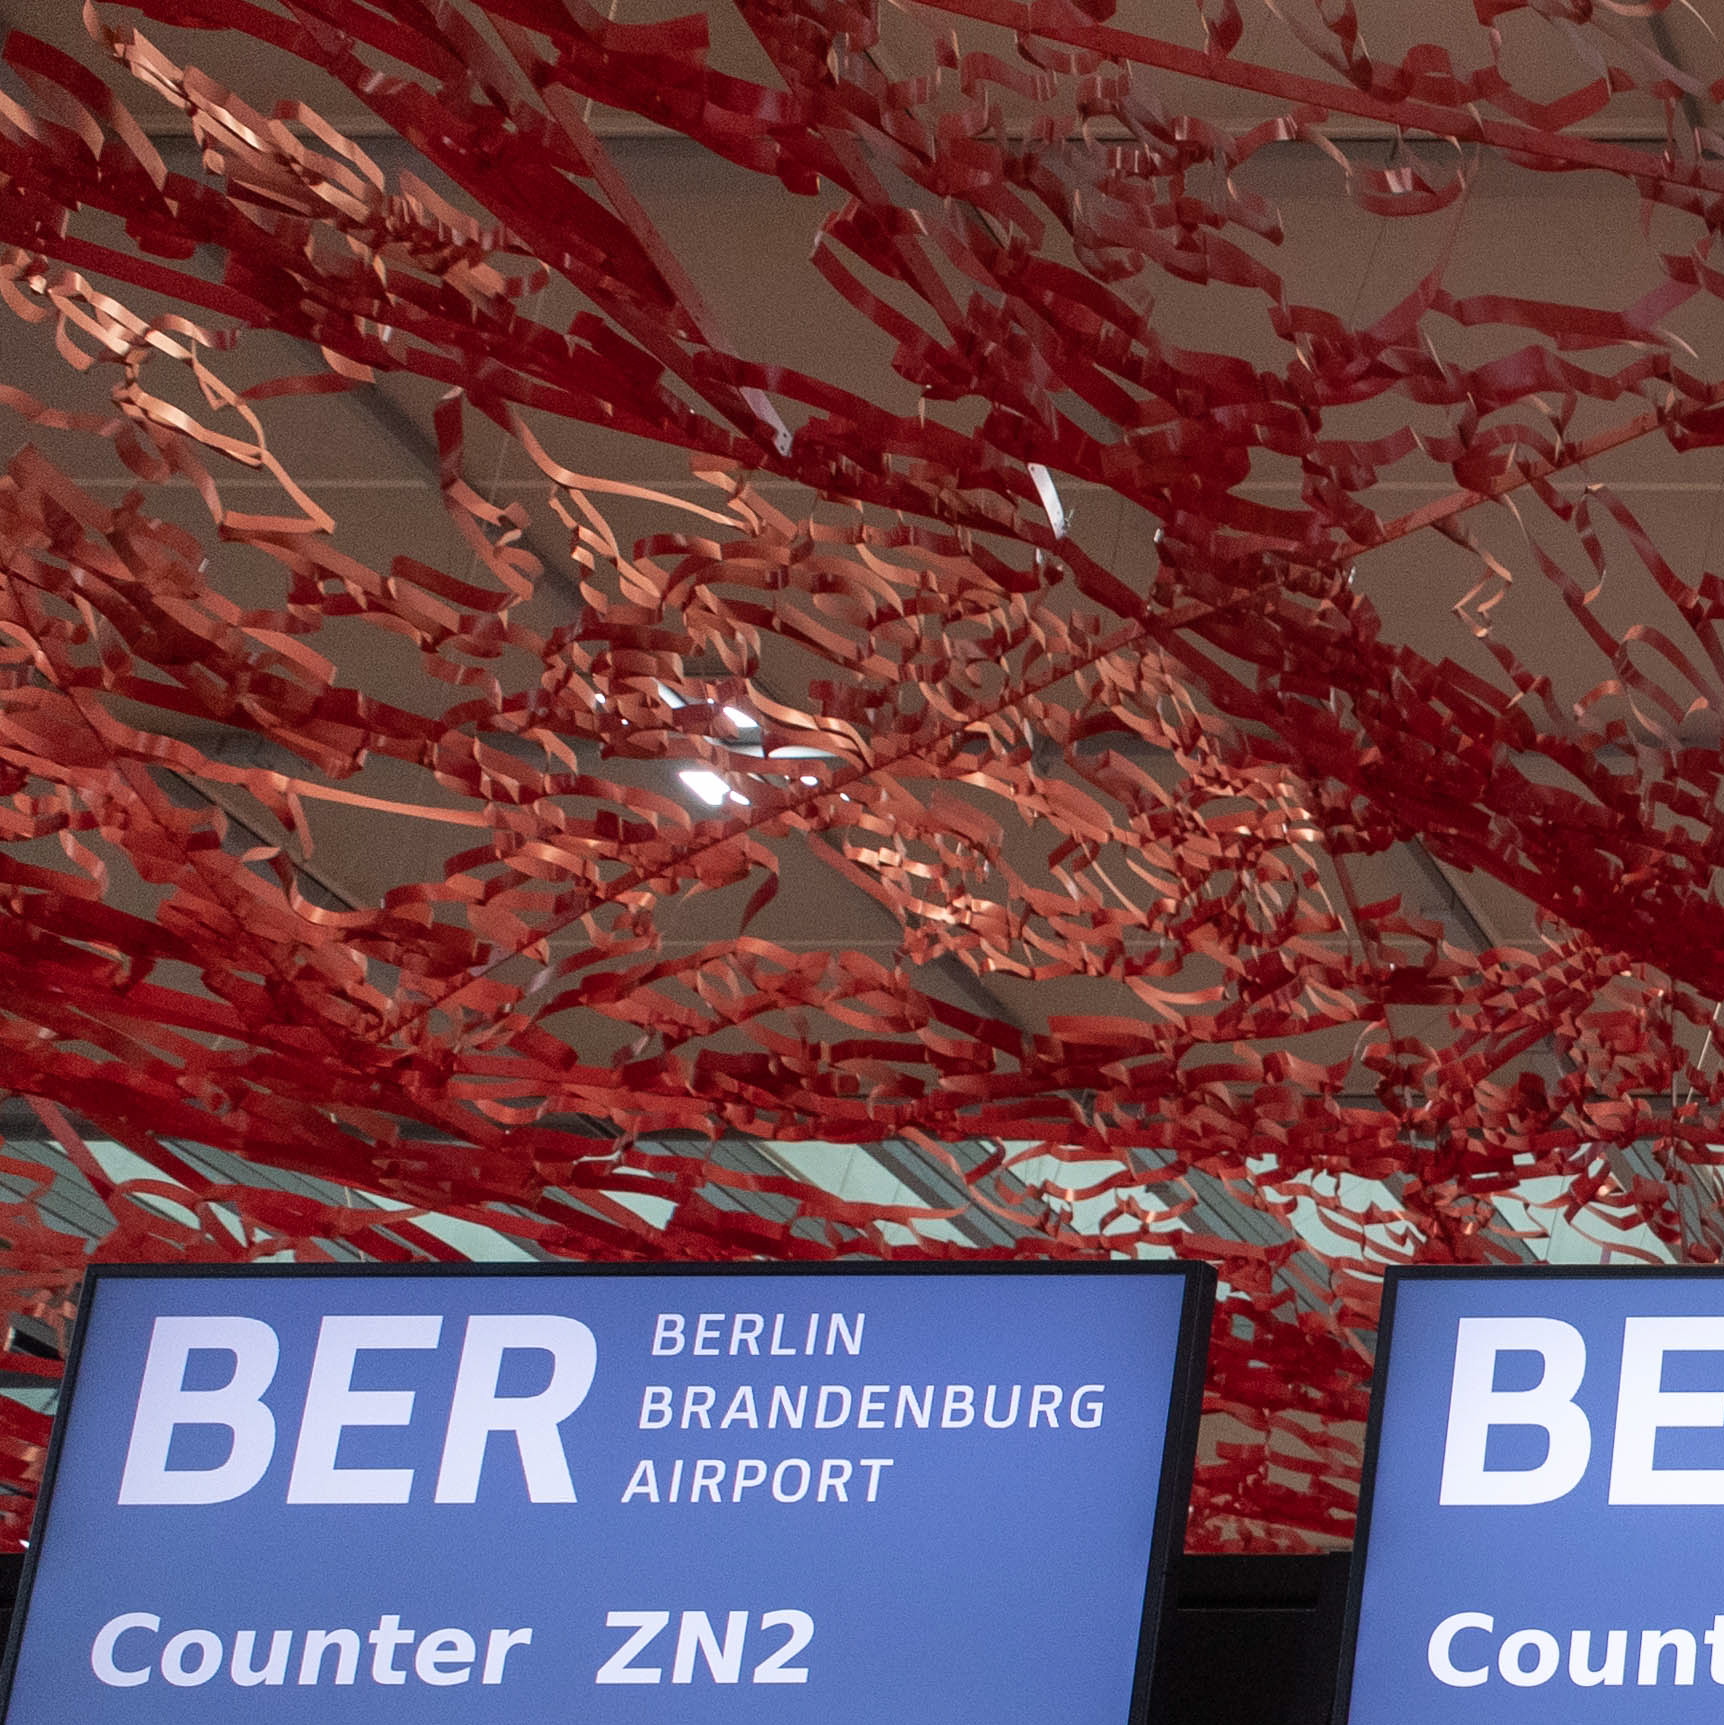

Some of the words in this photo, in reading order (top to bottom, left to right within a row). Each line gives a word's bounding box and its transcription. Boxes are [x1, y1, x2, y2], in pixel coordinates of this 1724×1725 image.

[651, 1313, 865, 1356] BERLIN
[117, 1314, 597, 1505] BER
[639, 1384, 1105, 1429] BRANDENBURG
[621, 1458, 894, 1503] AIRPORT
[91, 1612, 533, 1687] Counter
[595, 1609, 814, 1684] ZN2
